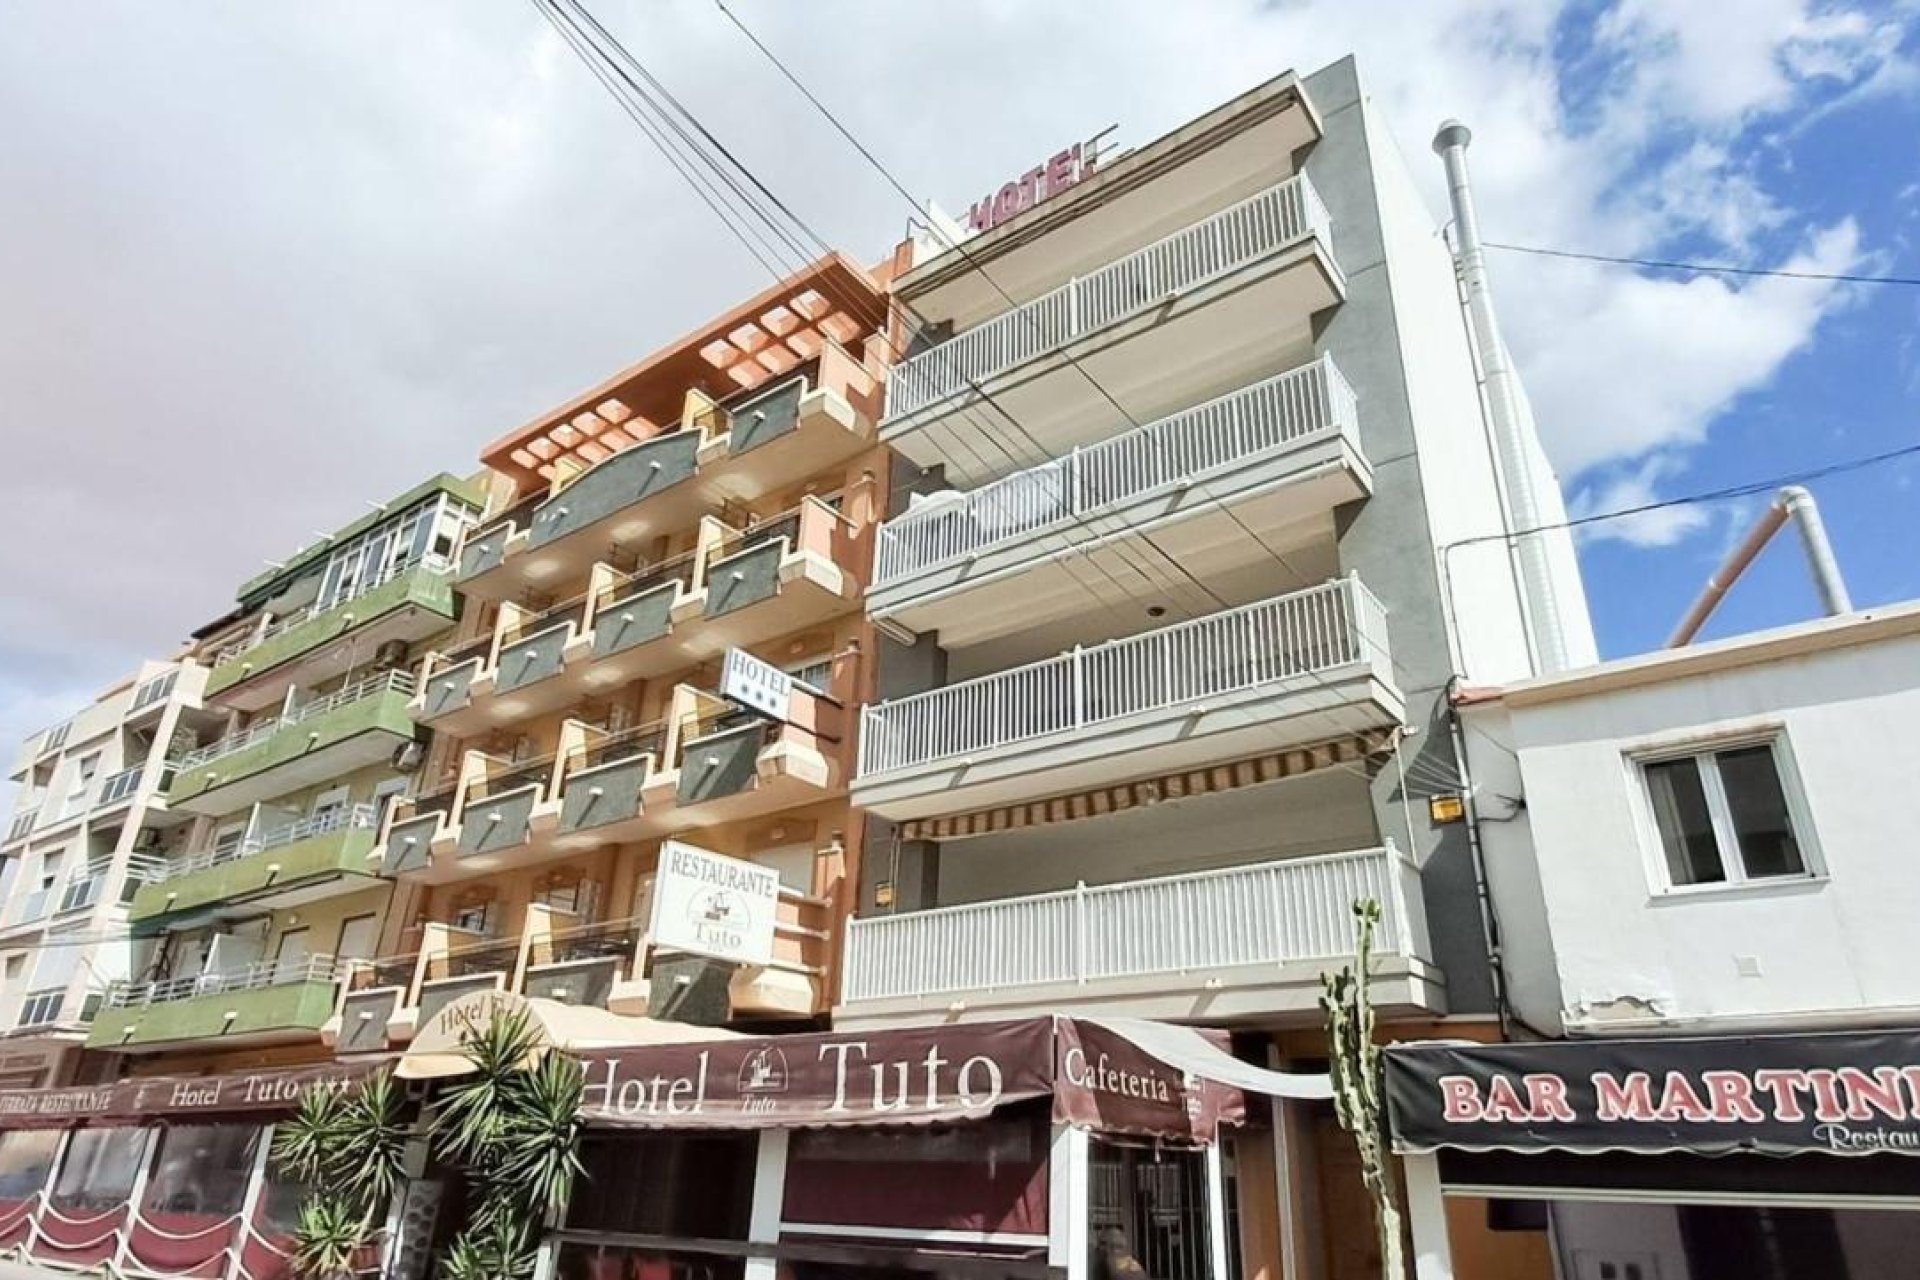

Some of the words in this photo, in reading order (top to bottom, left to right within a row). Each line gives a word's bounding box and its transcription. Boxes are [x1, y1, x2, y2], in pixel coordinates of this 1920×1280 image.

[731, 651, 789, 697] HOTEL
[670, 850, 774, 899] RESTAURANTE
[693, 920, 742, 949] Tuto
[168, 1080, 222, 1106] Hotel
[243, 1075, 299, 1102] Tuto
[573, 1050, 709, 1117] Hotel
[818, 1041, 1002, 1114] Tuto
[1064, 1048, 1170, 1102] Cafeteria
[1439, 1074, 1576, 1123] BAR
